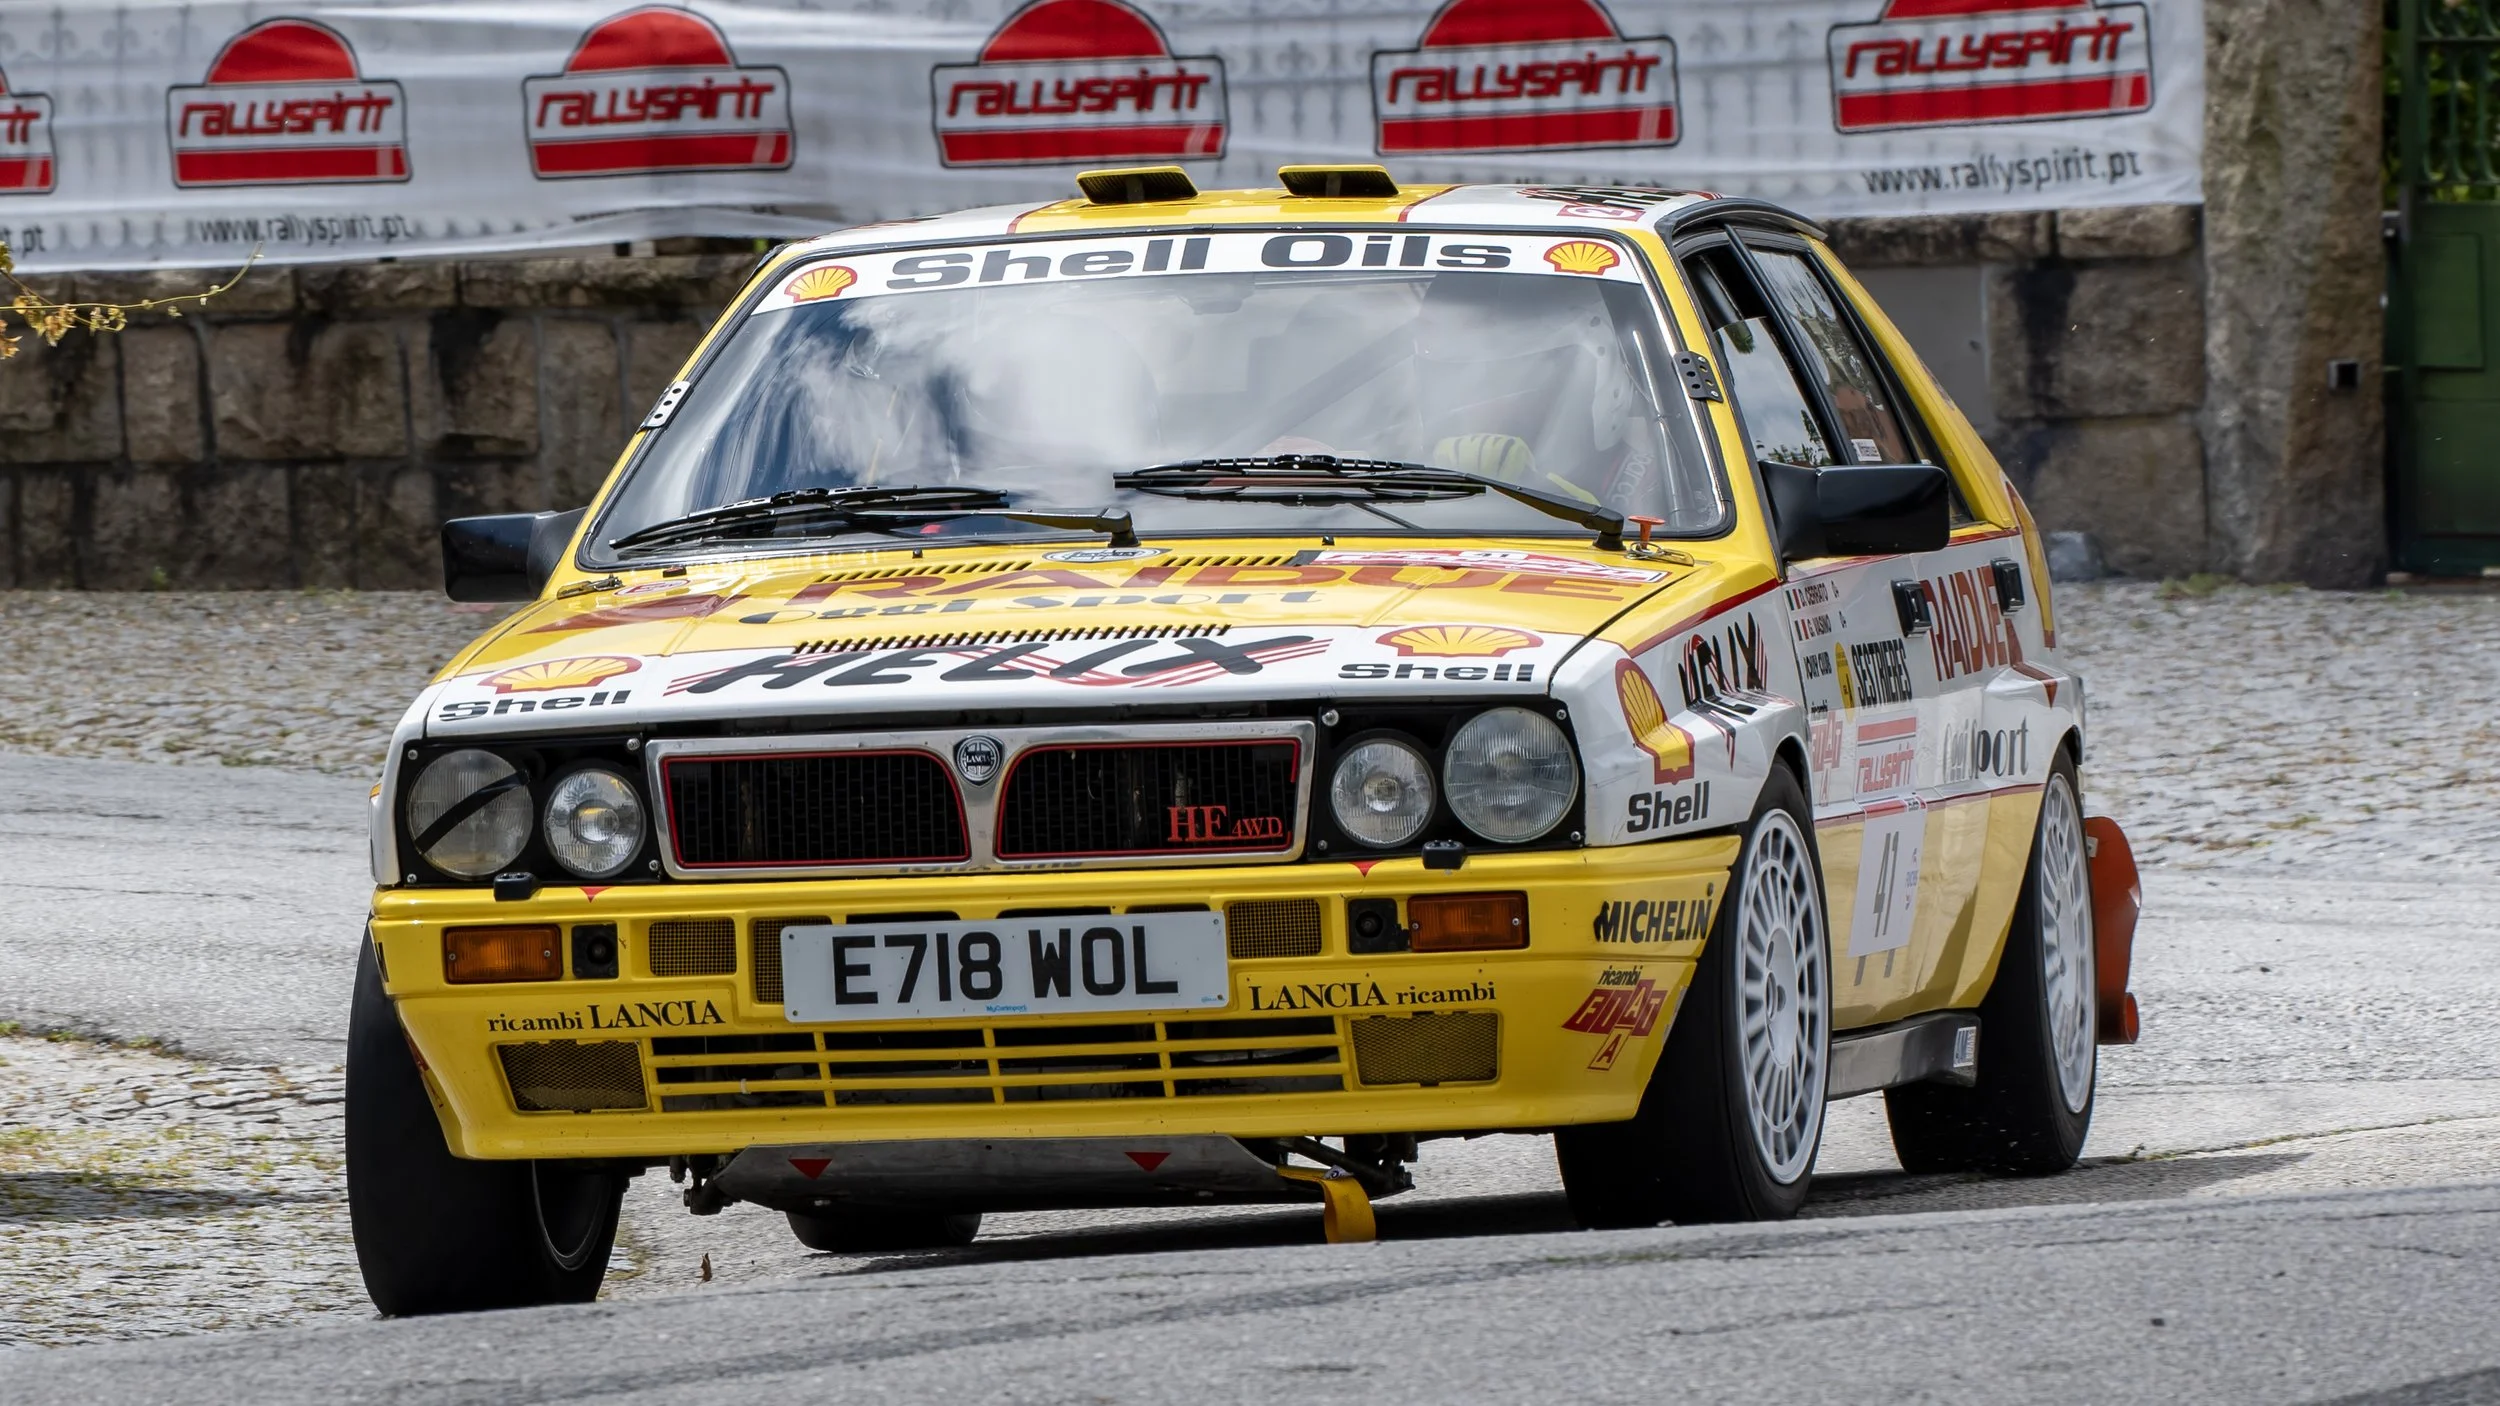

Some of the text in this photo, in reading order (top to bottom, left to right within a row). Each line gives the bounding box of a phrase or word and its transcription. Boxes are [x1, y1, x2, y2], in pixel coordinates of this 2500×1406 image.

[1843, 18, 2134, 79] rallyspirit
[535, 76, 774, 128] rallyspirit
[947, 67, 1211, 118] rallyspirit
[1387, 52, 1661, 105] rallyspirit
[178, 90, 394, 137] rallyspirit
[1862, 146, 2141, 195] www.rallyspirit.pt
[199, 213, 414, 249] www.rallyspirit.pt
[885, 231, 1513, 291] Shell Oils
[738, 589, 1322, 625] Oggi Sport
[784, 565, 1643, 606] RAIDUE
[684, 635, 1314, 694] HELIX
[1338, 662, 1536, 683] Shell
[1851, 637, 1913, 709] SESTRIERES
[439, 689, 631, 723] Shell
[1167, 805, 1284, 843] HF 4WD
[1626, 780, 1710, 833] Shell
[1594, 899, 1713, 944] MICHELIN
[832, 924, 1179, 1006] E718 WOL
[1597, 965, 1643, 985] ricambi
[486, 999, 727, 1034] ricambi LANCIA
[1248, 980, 1498, 1012] LANCIA ricambi
